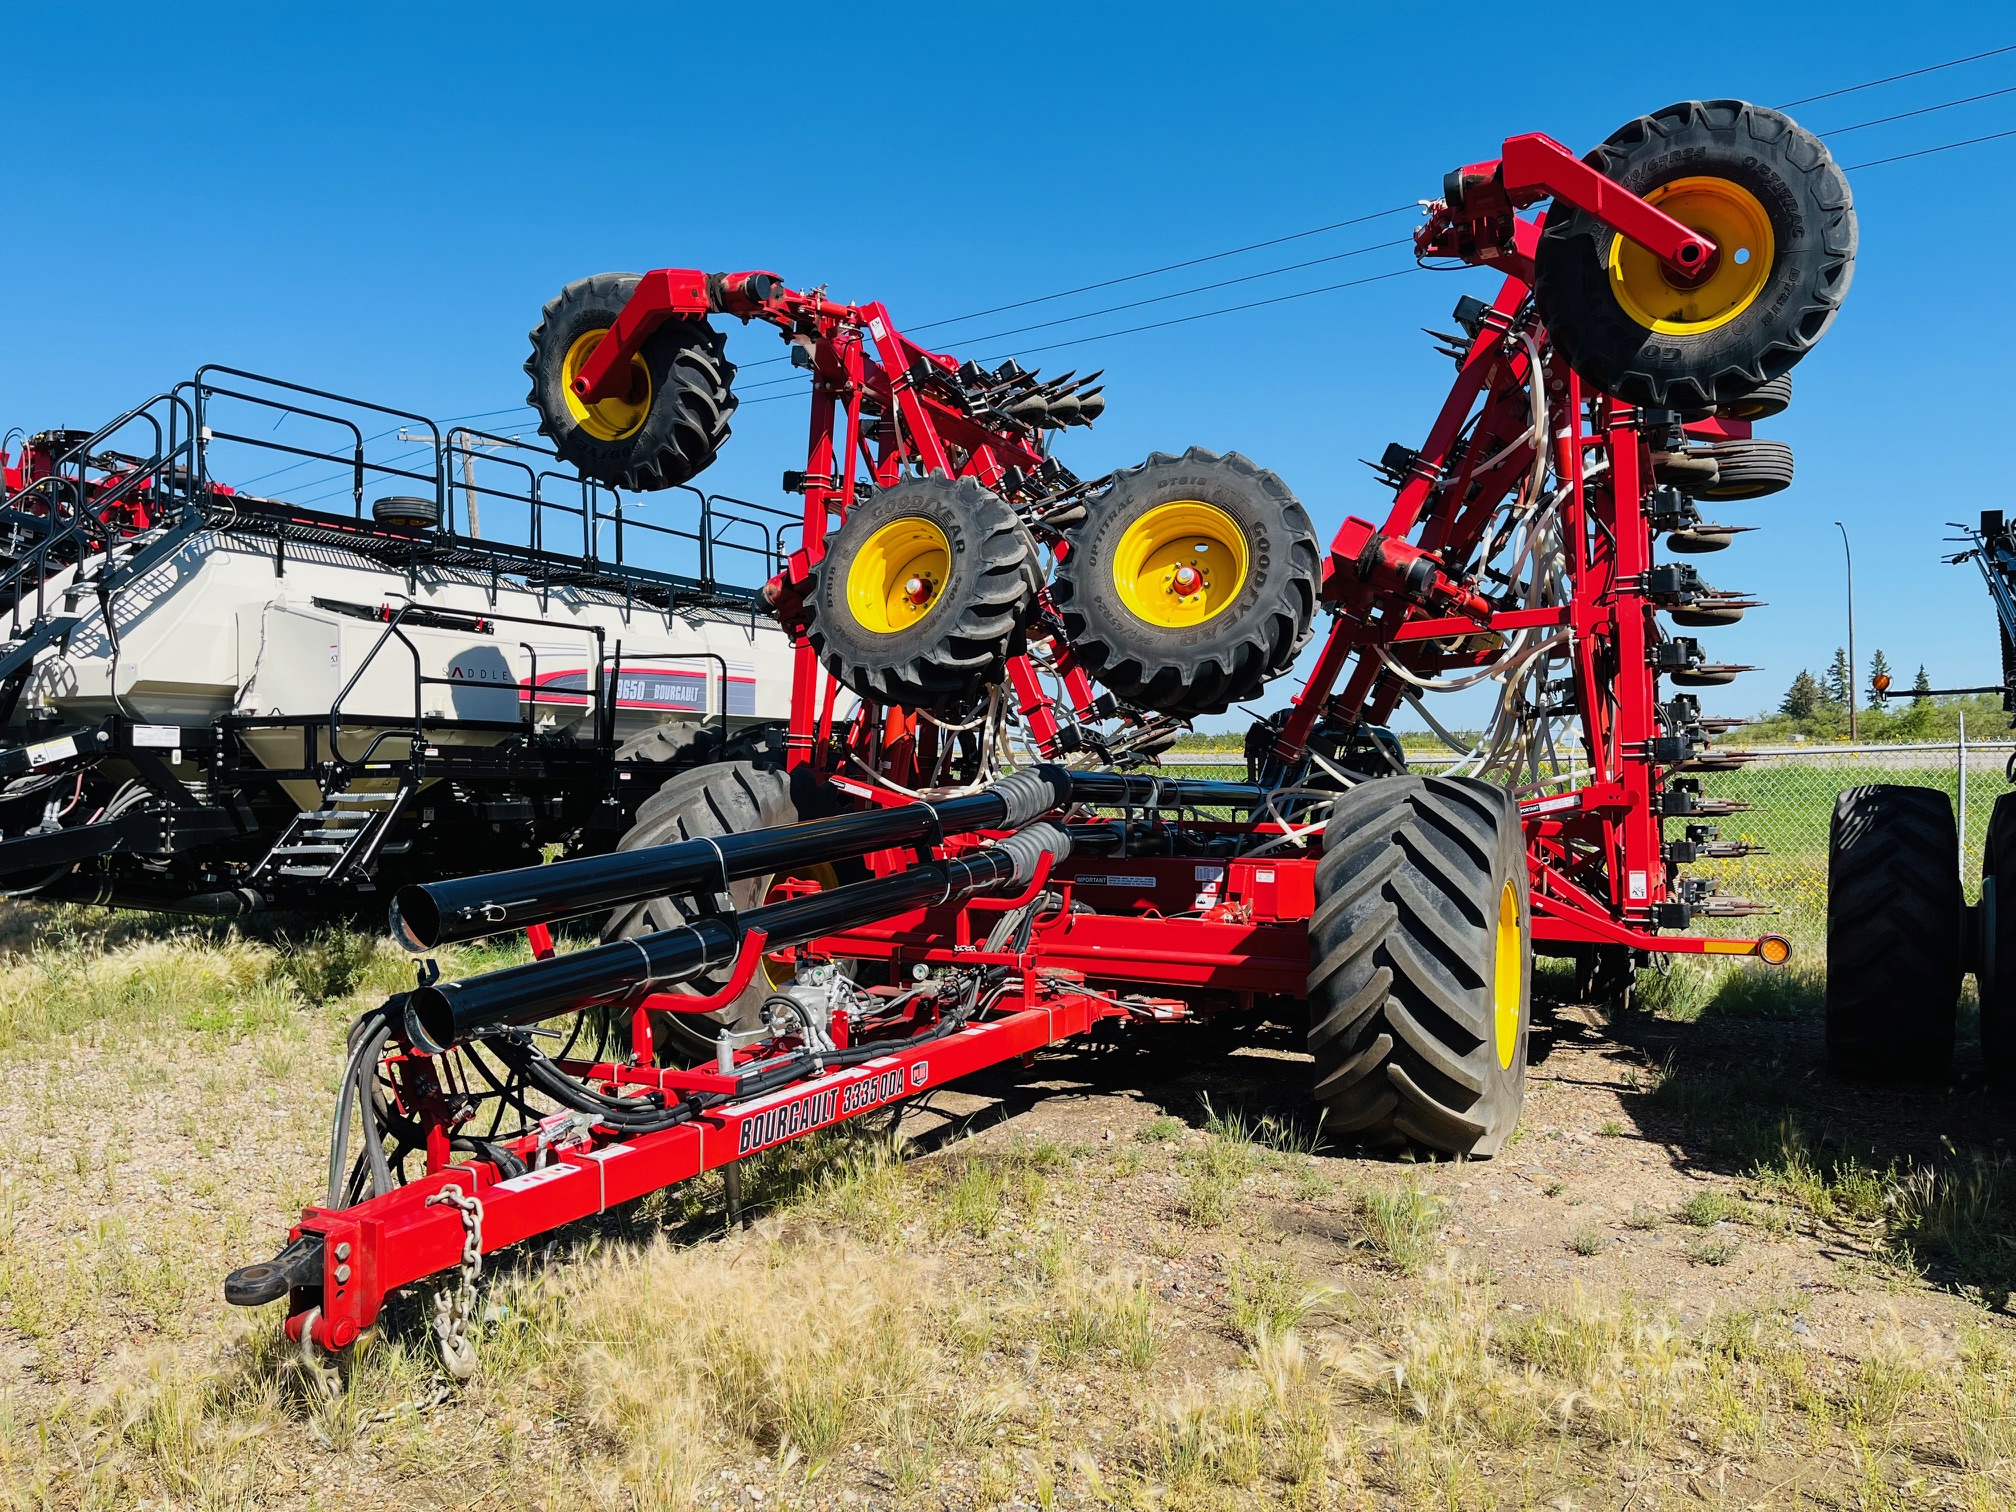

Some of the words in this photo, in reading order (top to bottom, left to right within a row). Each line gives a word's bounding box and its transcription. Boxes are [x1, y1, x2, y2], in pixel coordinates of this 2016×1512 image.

[1621, 146, 1707, 188] 40/65R24
[1742, 156, 1806, 240] OPTITRAC
[1156, 476, 1207, 490] DT818
[871, 495, 966, 555] GOODYEAR
[1088, 494, 1136, 568] OPTITRAC
[1179, 521, 1271, 648] GOODYEAR
[442, 666, 508, 680] SADDLE
[653, 684, 700, 702] BOURGAULT
[738, 1085, 840, 1155] BOURGAULT
